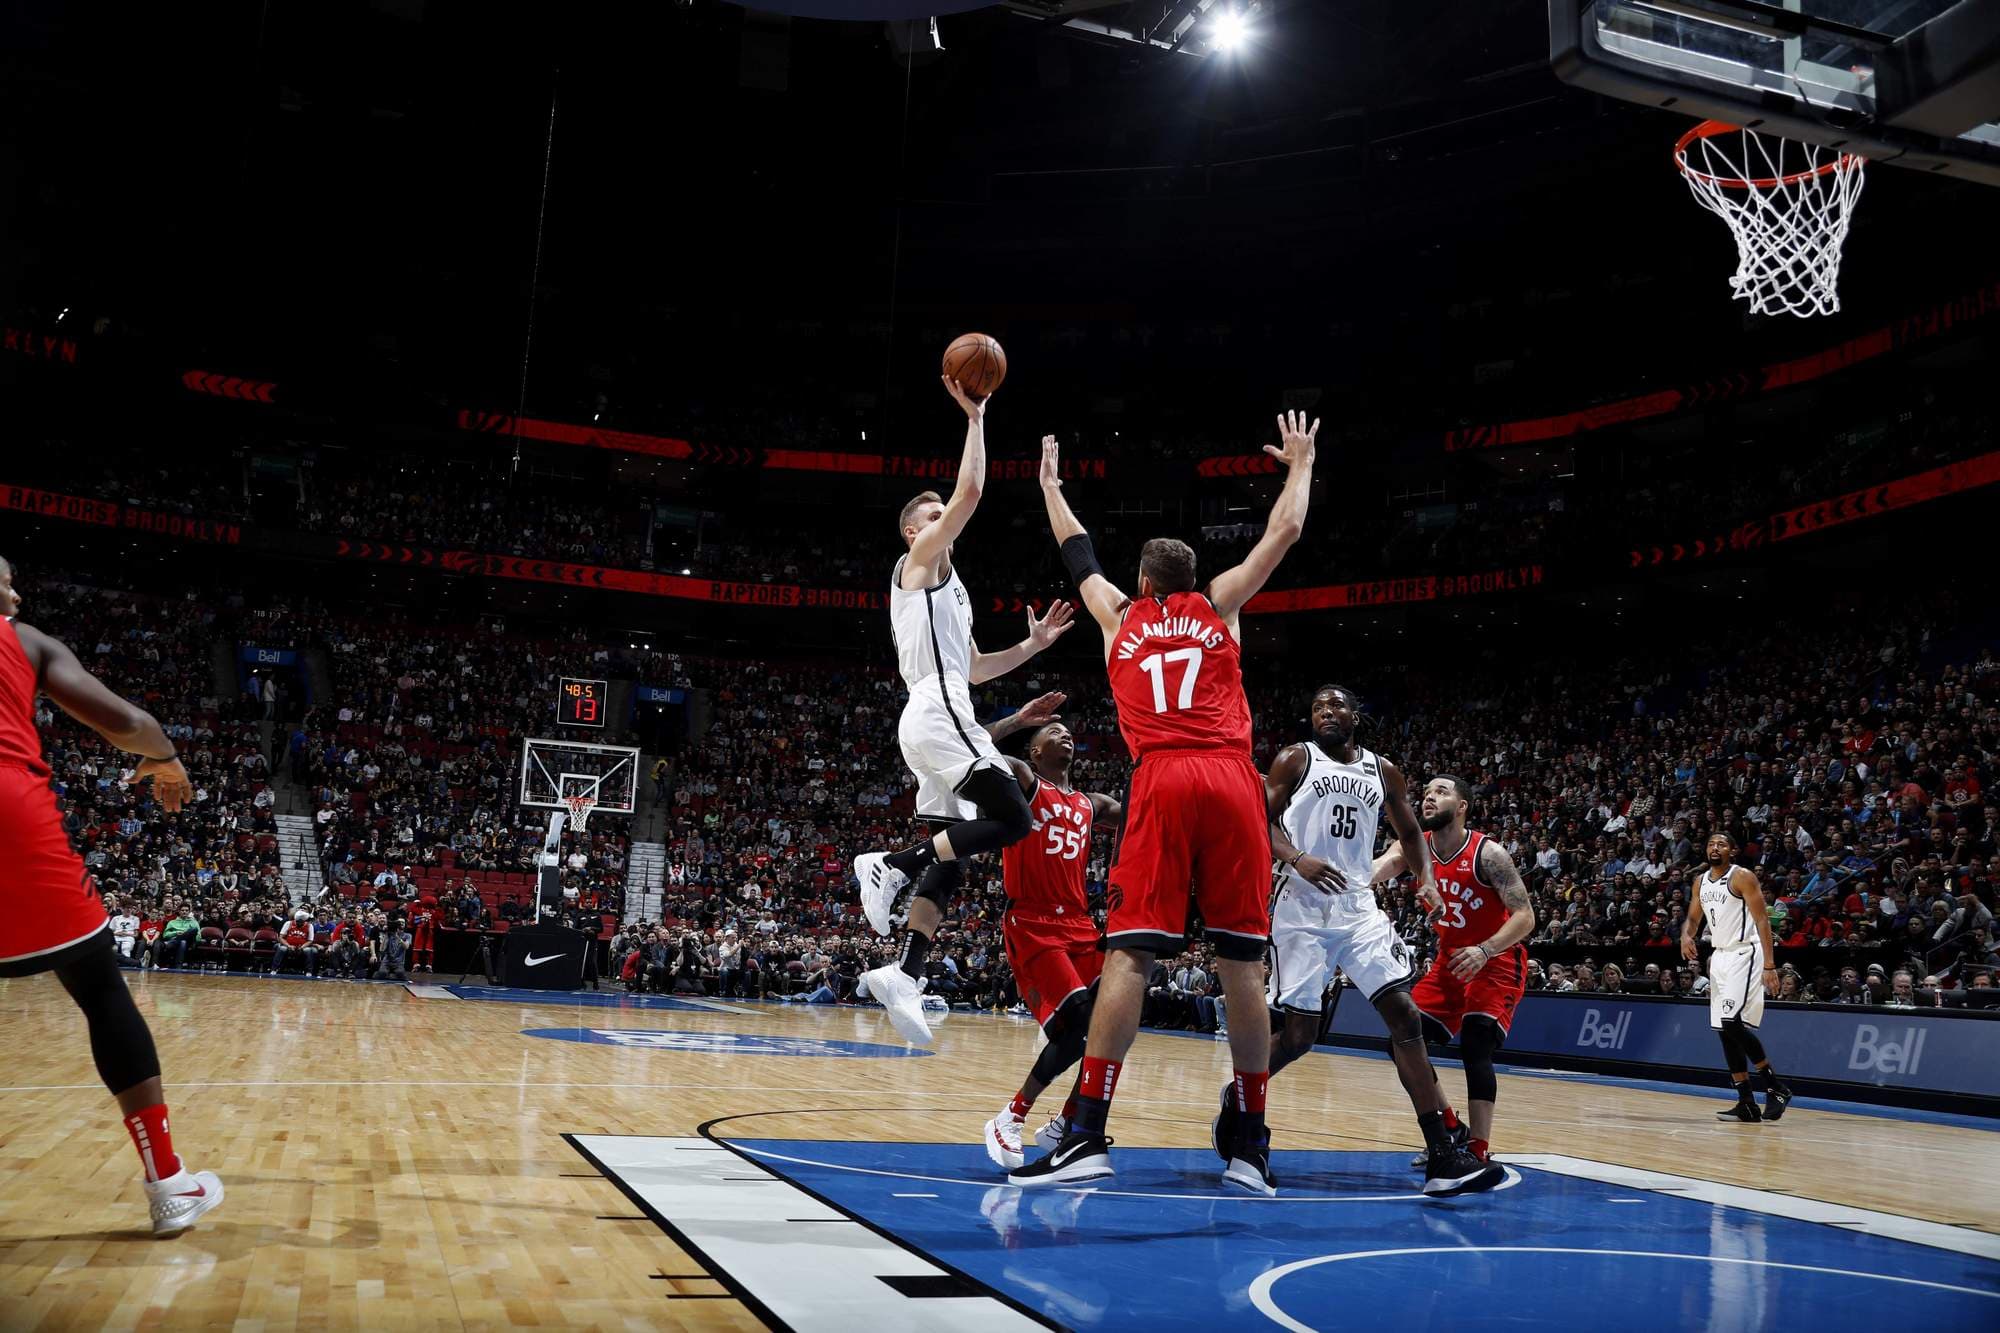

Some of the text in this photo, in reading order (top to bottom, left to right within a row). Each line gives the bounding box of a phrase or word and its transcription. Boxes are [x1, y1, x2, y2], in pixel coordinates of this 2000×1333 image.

[9, 487, 241, 544] RAPTORS BROOKLYN
[711, 582, 890, 608] RAPTORS BROOKLY
[1347, 563, 1546, 603] RAPTORS BROOKLYN
[1117, 616, 1224, 660] VALANCIUNAS
[258, 649, 280, 663] Bell
[564, 683, 593, 698] 48.5
[651, 688, 671, 703] Bell
[1138, 647, 1203, 714] 17
[575, 698, 598, 721] 13
[1312, 775, 1380, 808] BROOKLYN
[1330, 804, 1358, 840] 35
[1045, 824, 1081, 860] 55
[1435, 878, 1484, 911] TORS
[1710, 907, 1716, 927] 8
[1576, 1008, 1633, 1050] Bell
[1847, 1024, 1928, 1075] Bell
